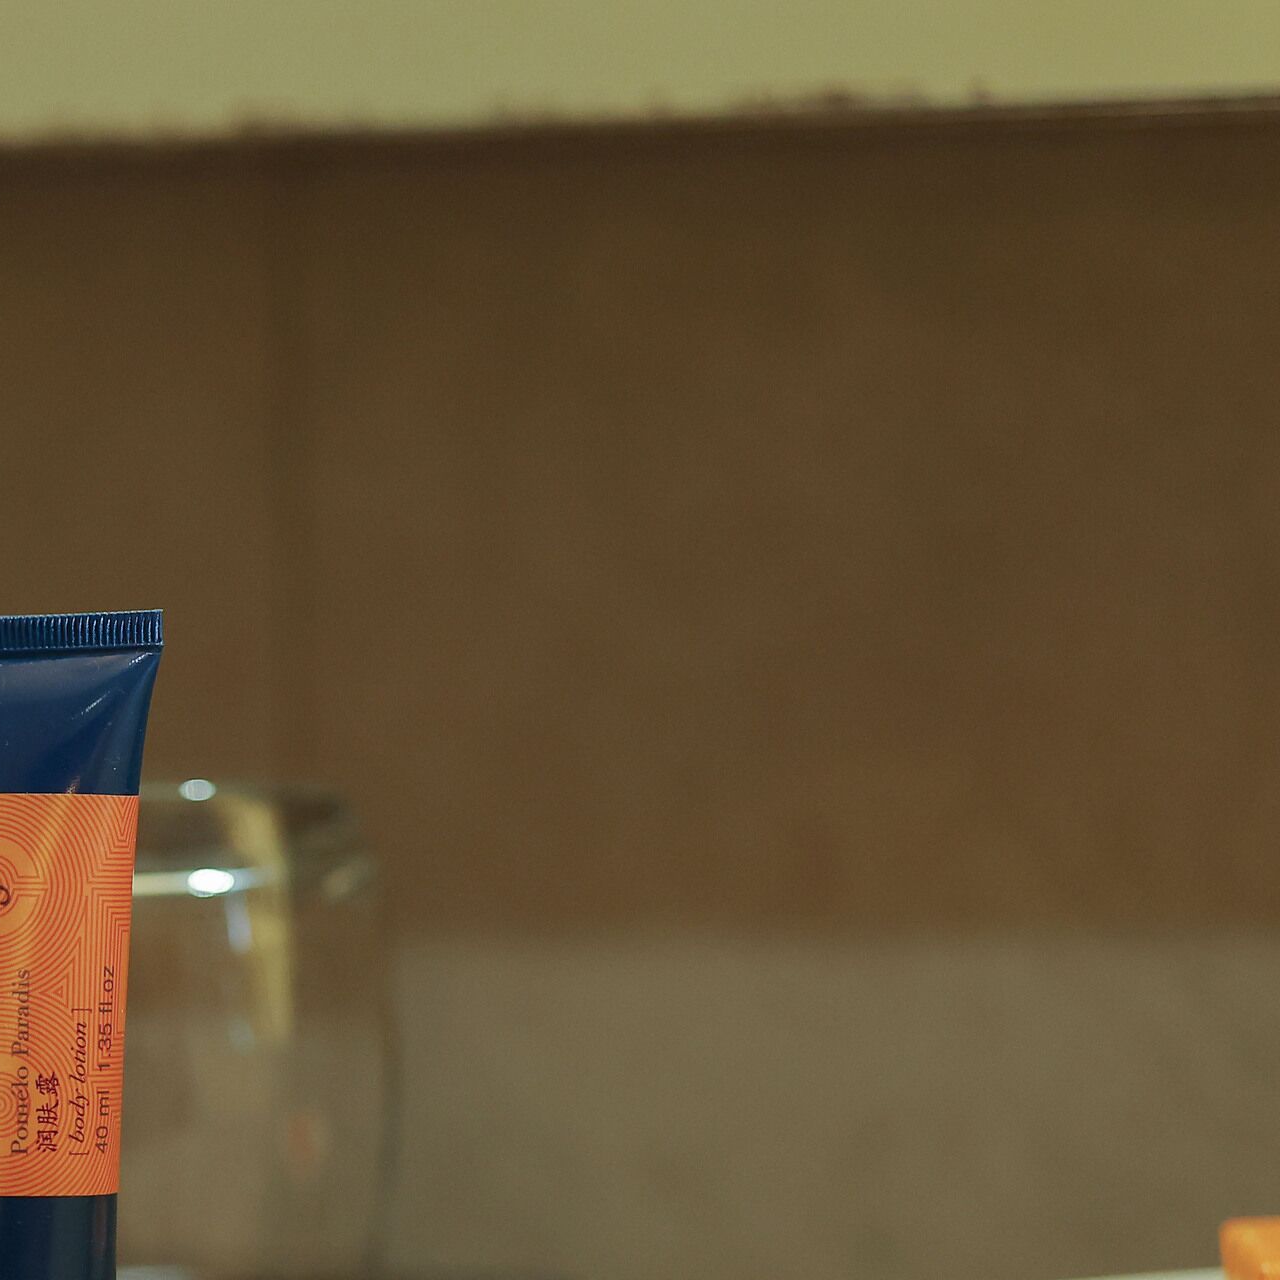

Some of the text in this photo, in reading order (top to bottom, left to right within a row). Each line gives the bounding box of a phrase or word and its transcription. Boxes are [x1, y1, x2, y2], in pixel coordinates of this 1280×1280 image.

[10, 969, 31, 1155] Pomélo Paradis
[70, 1022, 87, 1084] lotion
[95, 965, 115, 1154] 40 ml 1.35 fl.oz
[35, 1071, 60, 1153] 润肤露
[68, 1088, 90, 1143] body
